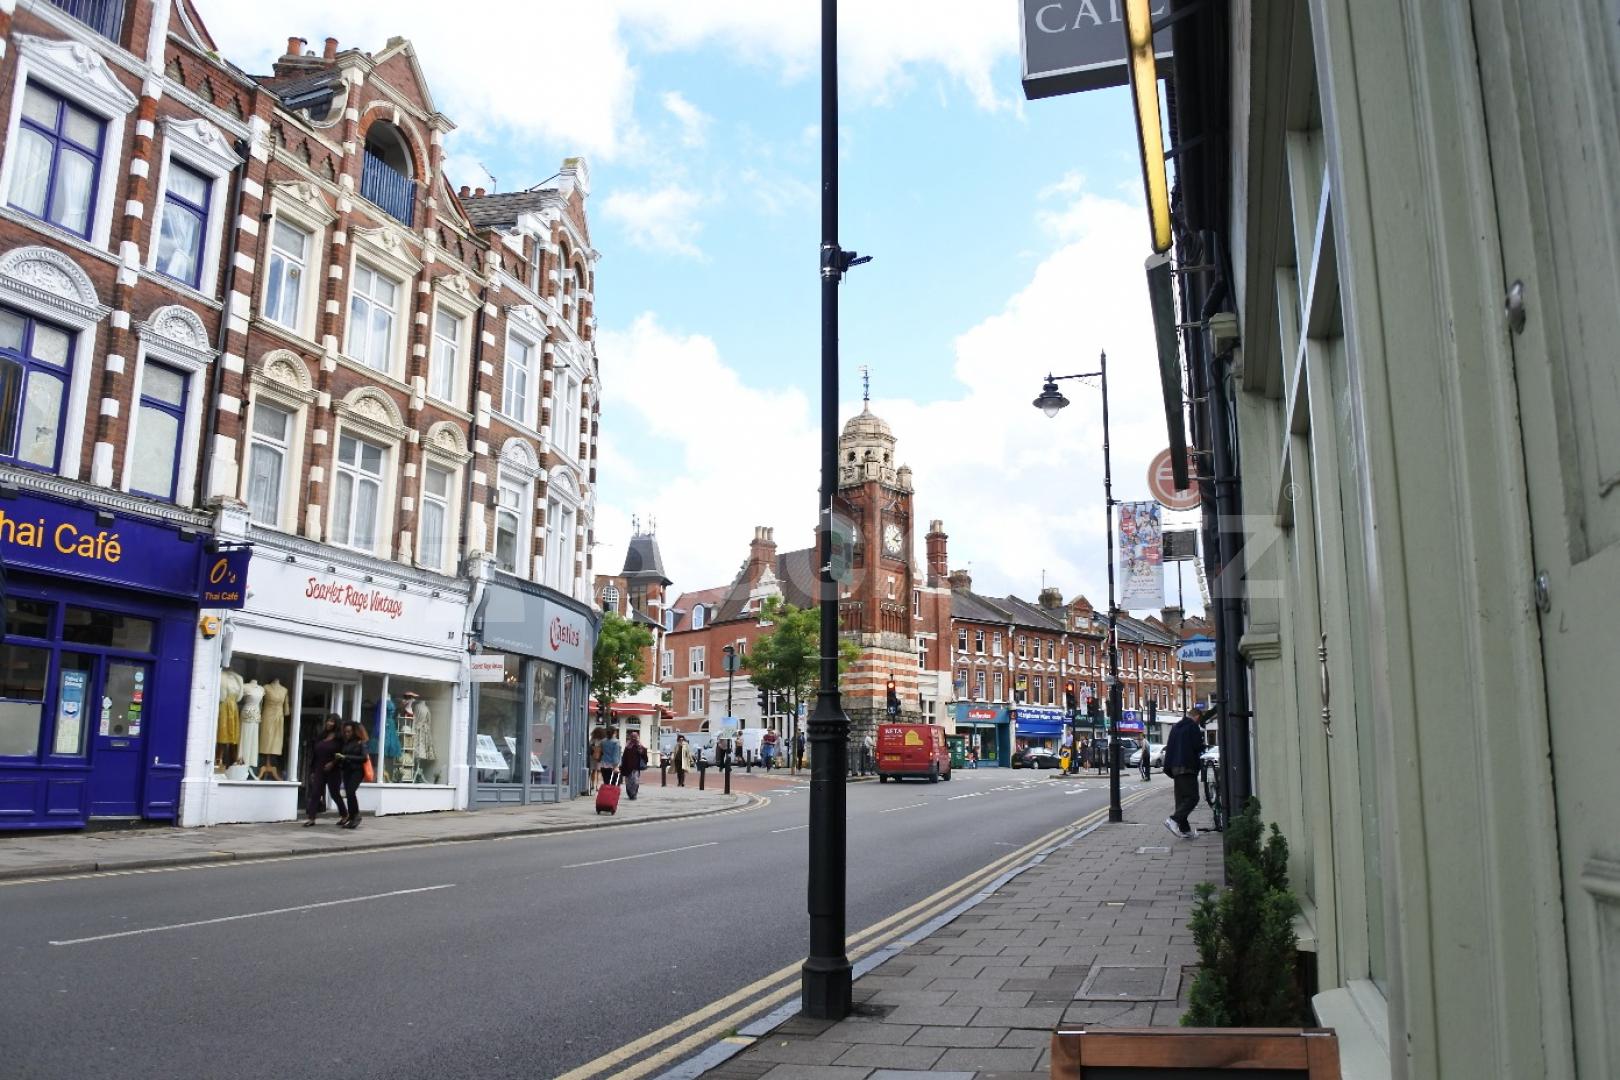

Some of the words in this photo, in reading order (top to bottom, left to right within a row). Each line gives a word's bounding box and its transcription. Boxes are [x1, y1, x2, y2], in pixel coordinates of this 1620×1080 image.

[1035, 0, 1165, 33] CA
[54, 523, 122, 563] Café
[205, 592, 220, 601] Thai
[221, 592, 239, 601] Café
[305, 577, 344, 603] Scarlet
[344, 584, 369, 613] Rage
[370, 590, 404, 619] Vintage
